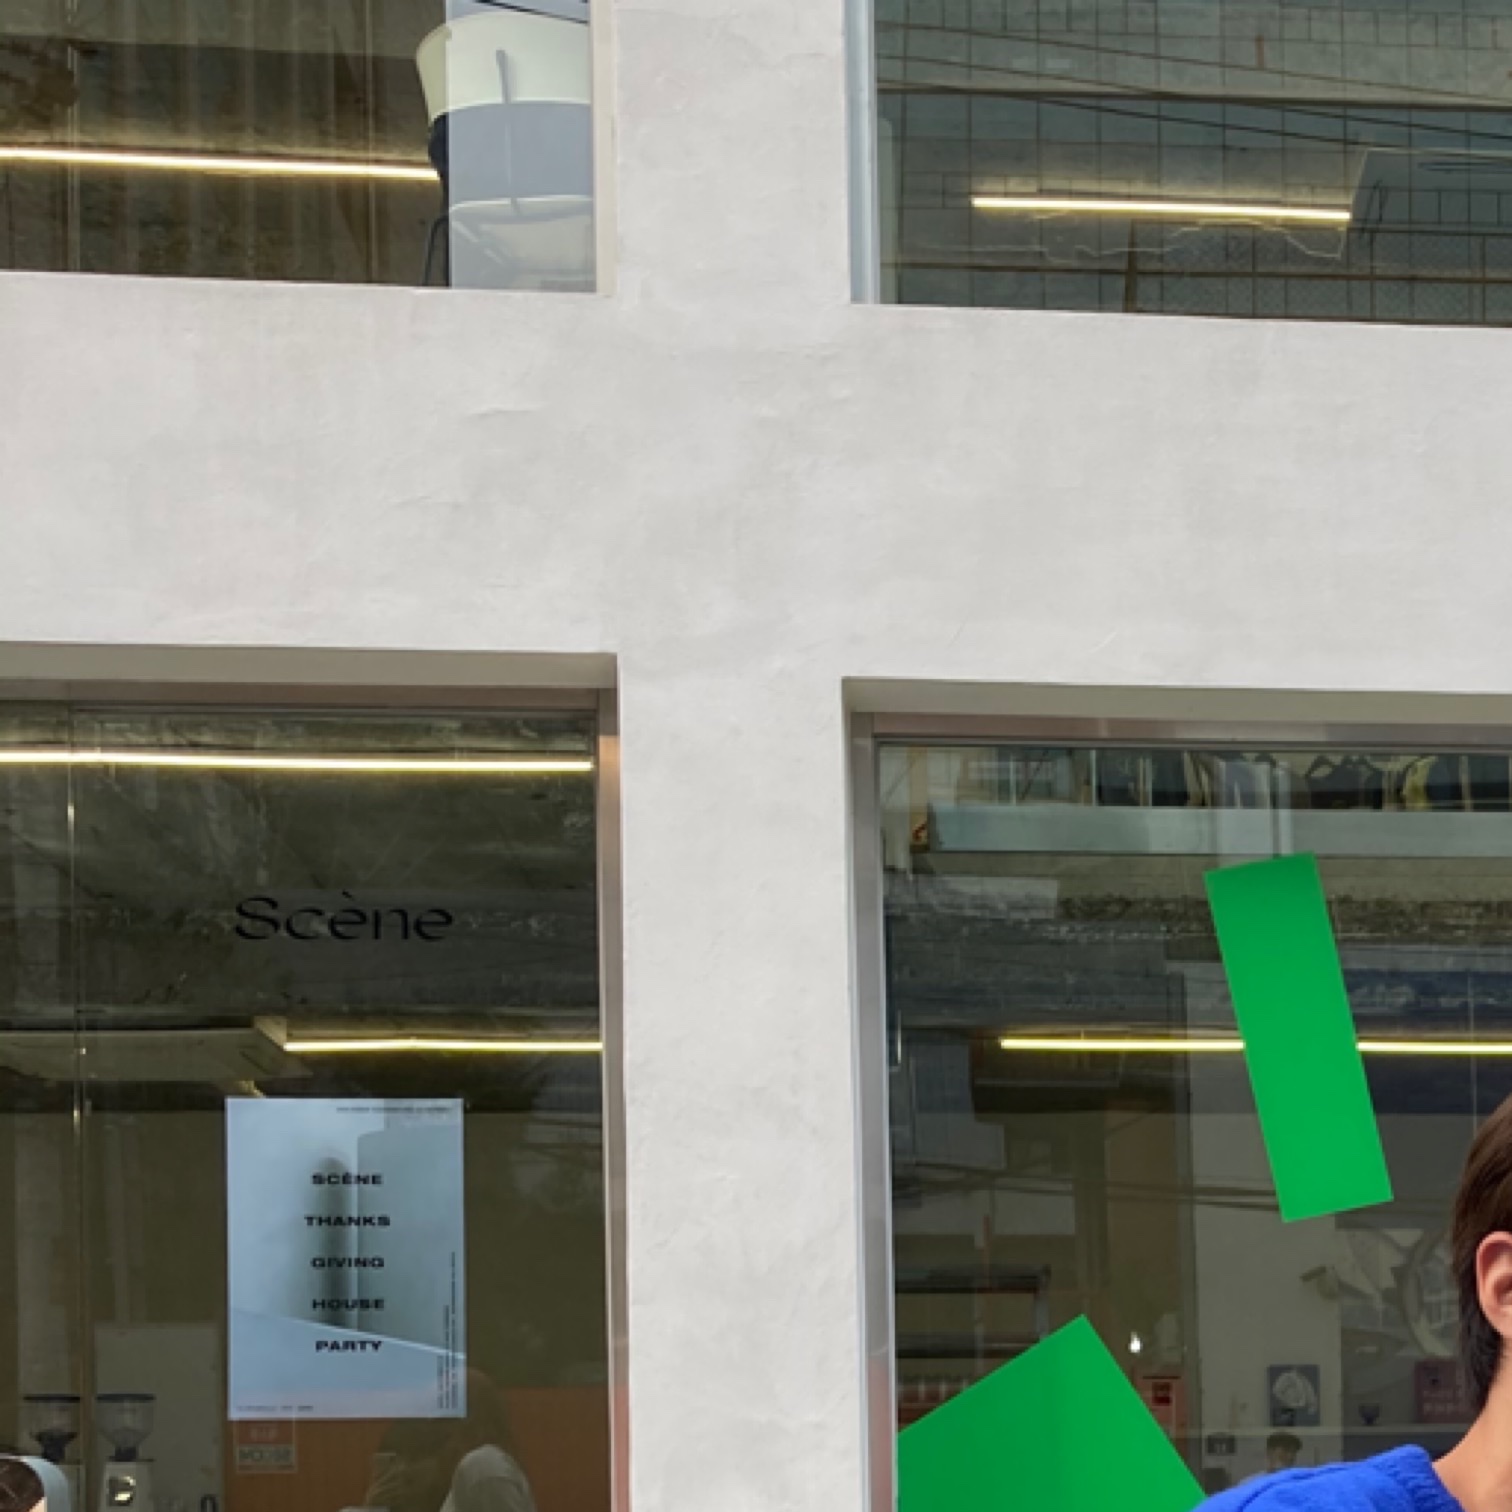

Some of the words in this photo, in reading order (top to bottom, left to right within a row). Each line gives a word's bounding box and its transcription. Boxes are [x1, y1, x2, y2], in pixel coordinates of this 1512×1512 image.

[235, 890, 453, 940] Scène
[303, 1215, 391, 1227] THANKS
[310, 1257, 385, 1269] GIVING
[312, 1298, 385, 1311] HOUSE
[315, 1340, 382, 1352] PARTY
